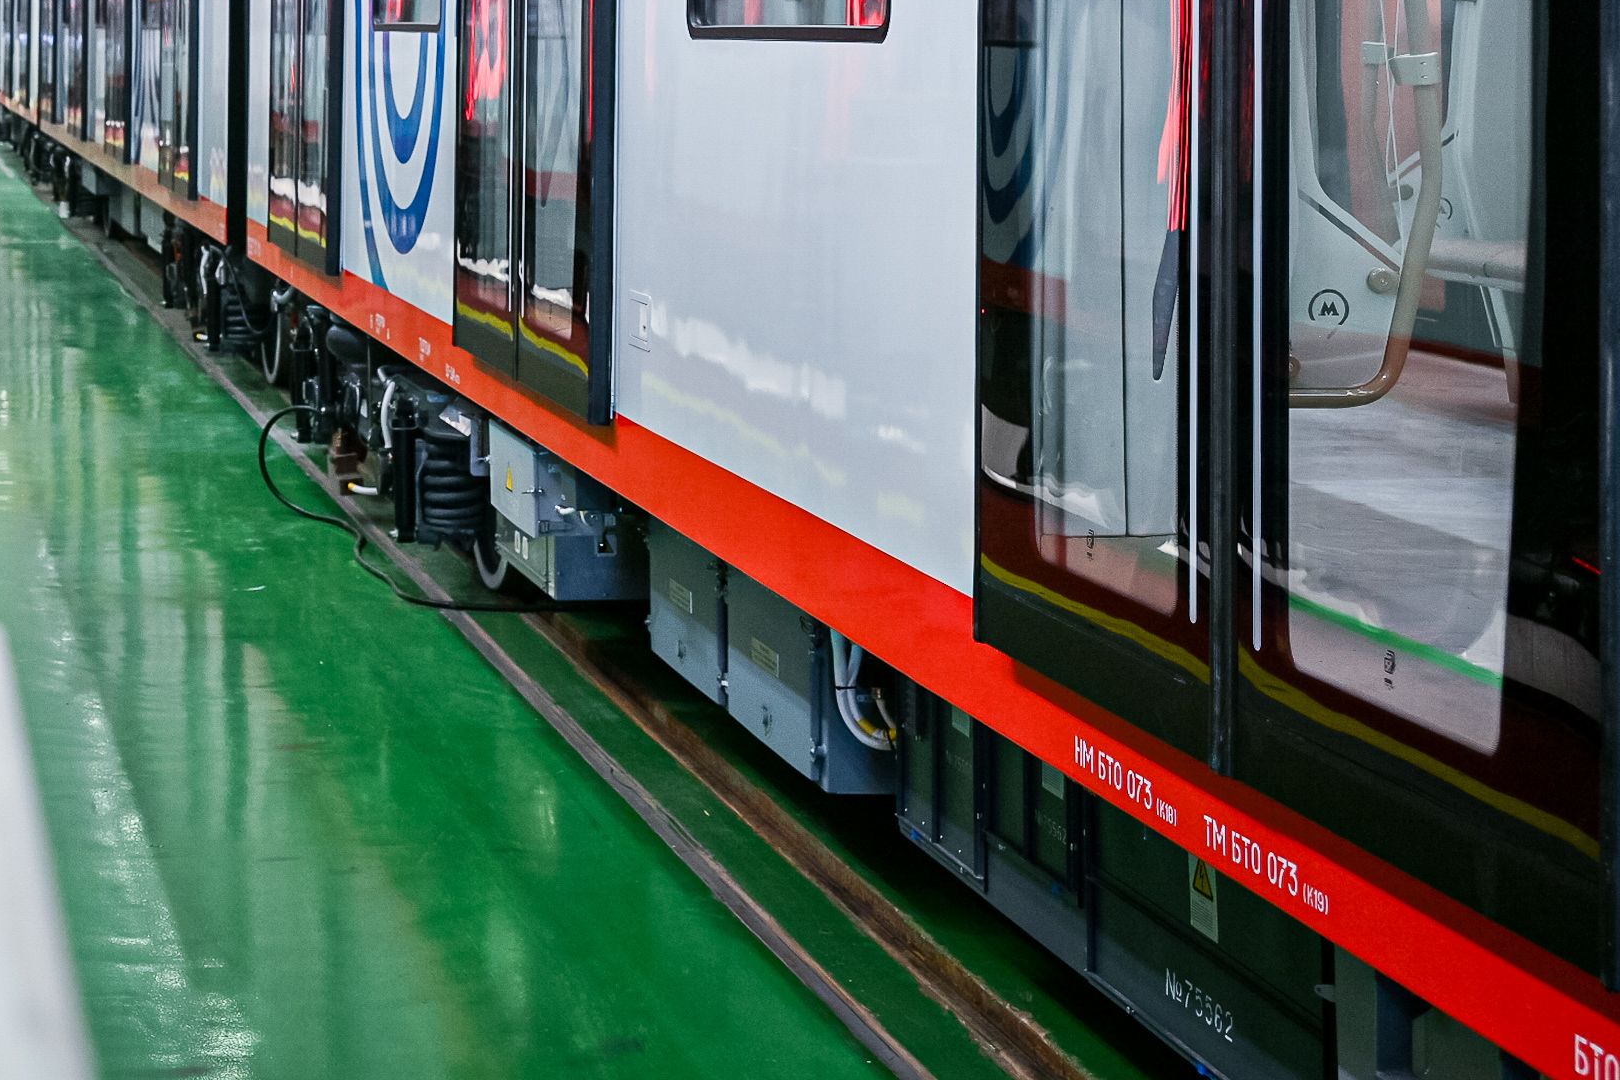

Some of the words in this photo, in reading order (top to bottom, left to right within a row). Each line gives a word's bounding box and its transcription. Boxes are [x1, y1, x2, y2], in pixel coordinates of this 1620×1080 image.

[1074, 735, 1094, 774] НМ
[1098, 750, 1122, 790] БТО
[1127, 769, 1152, 810] 073
[1203, 814, 1226, 856] ТМ
[1231, 830, 1261, 875] БТО
[1267, 851, 1298, 897] 073
[1303, 882, 1329, 915] (К19)
